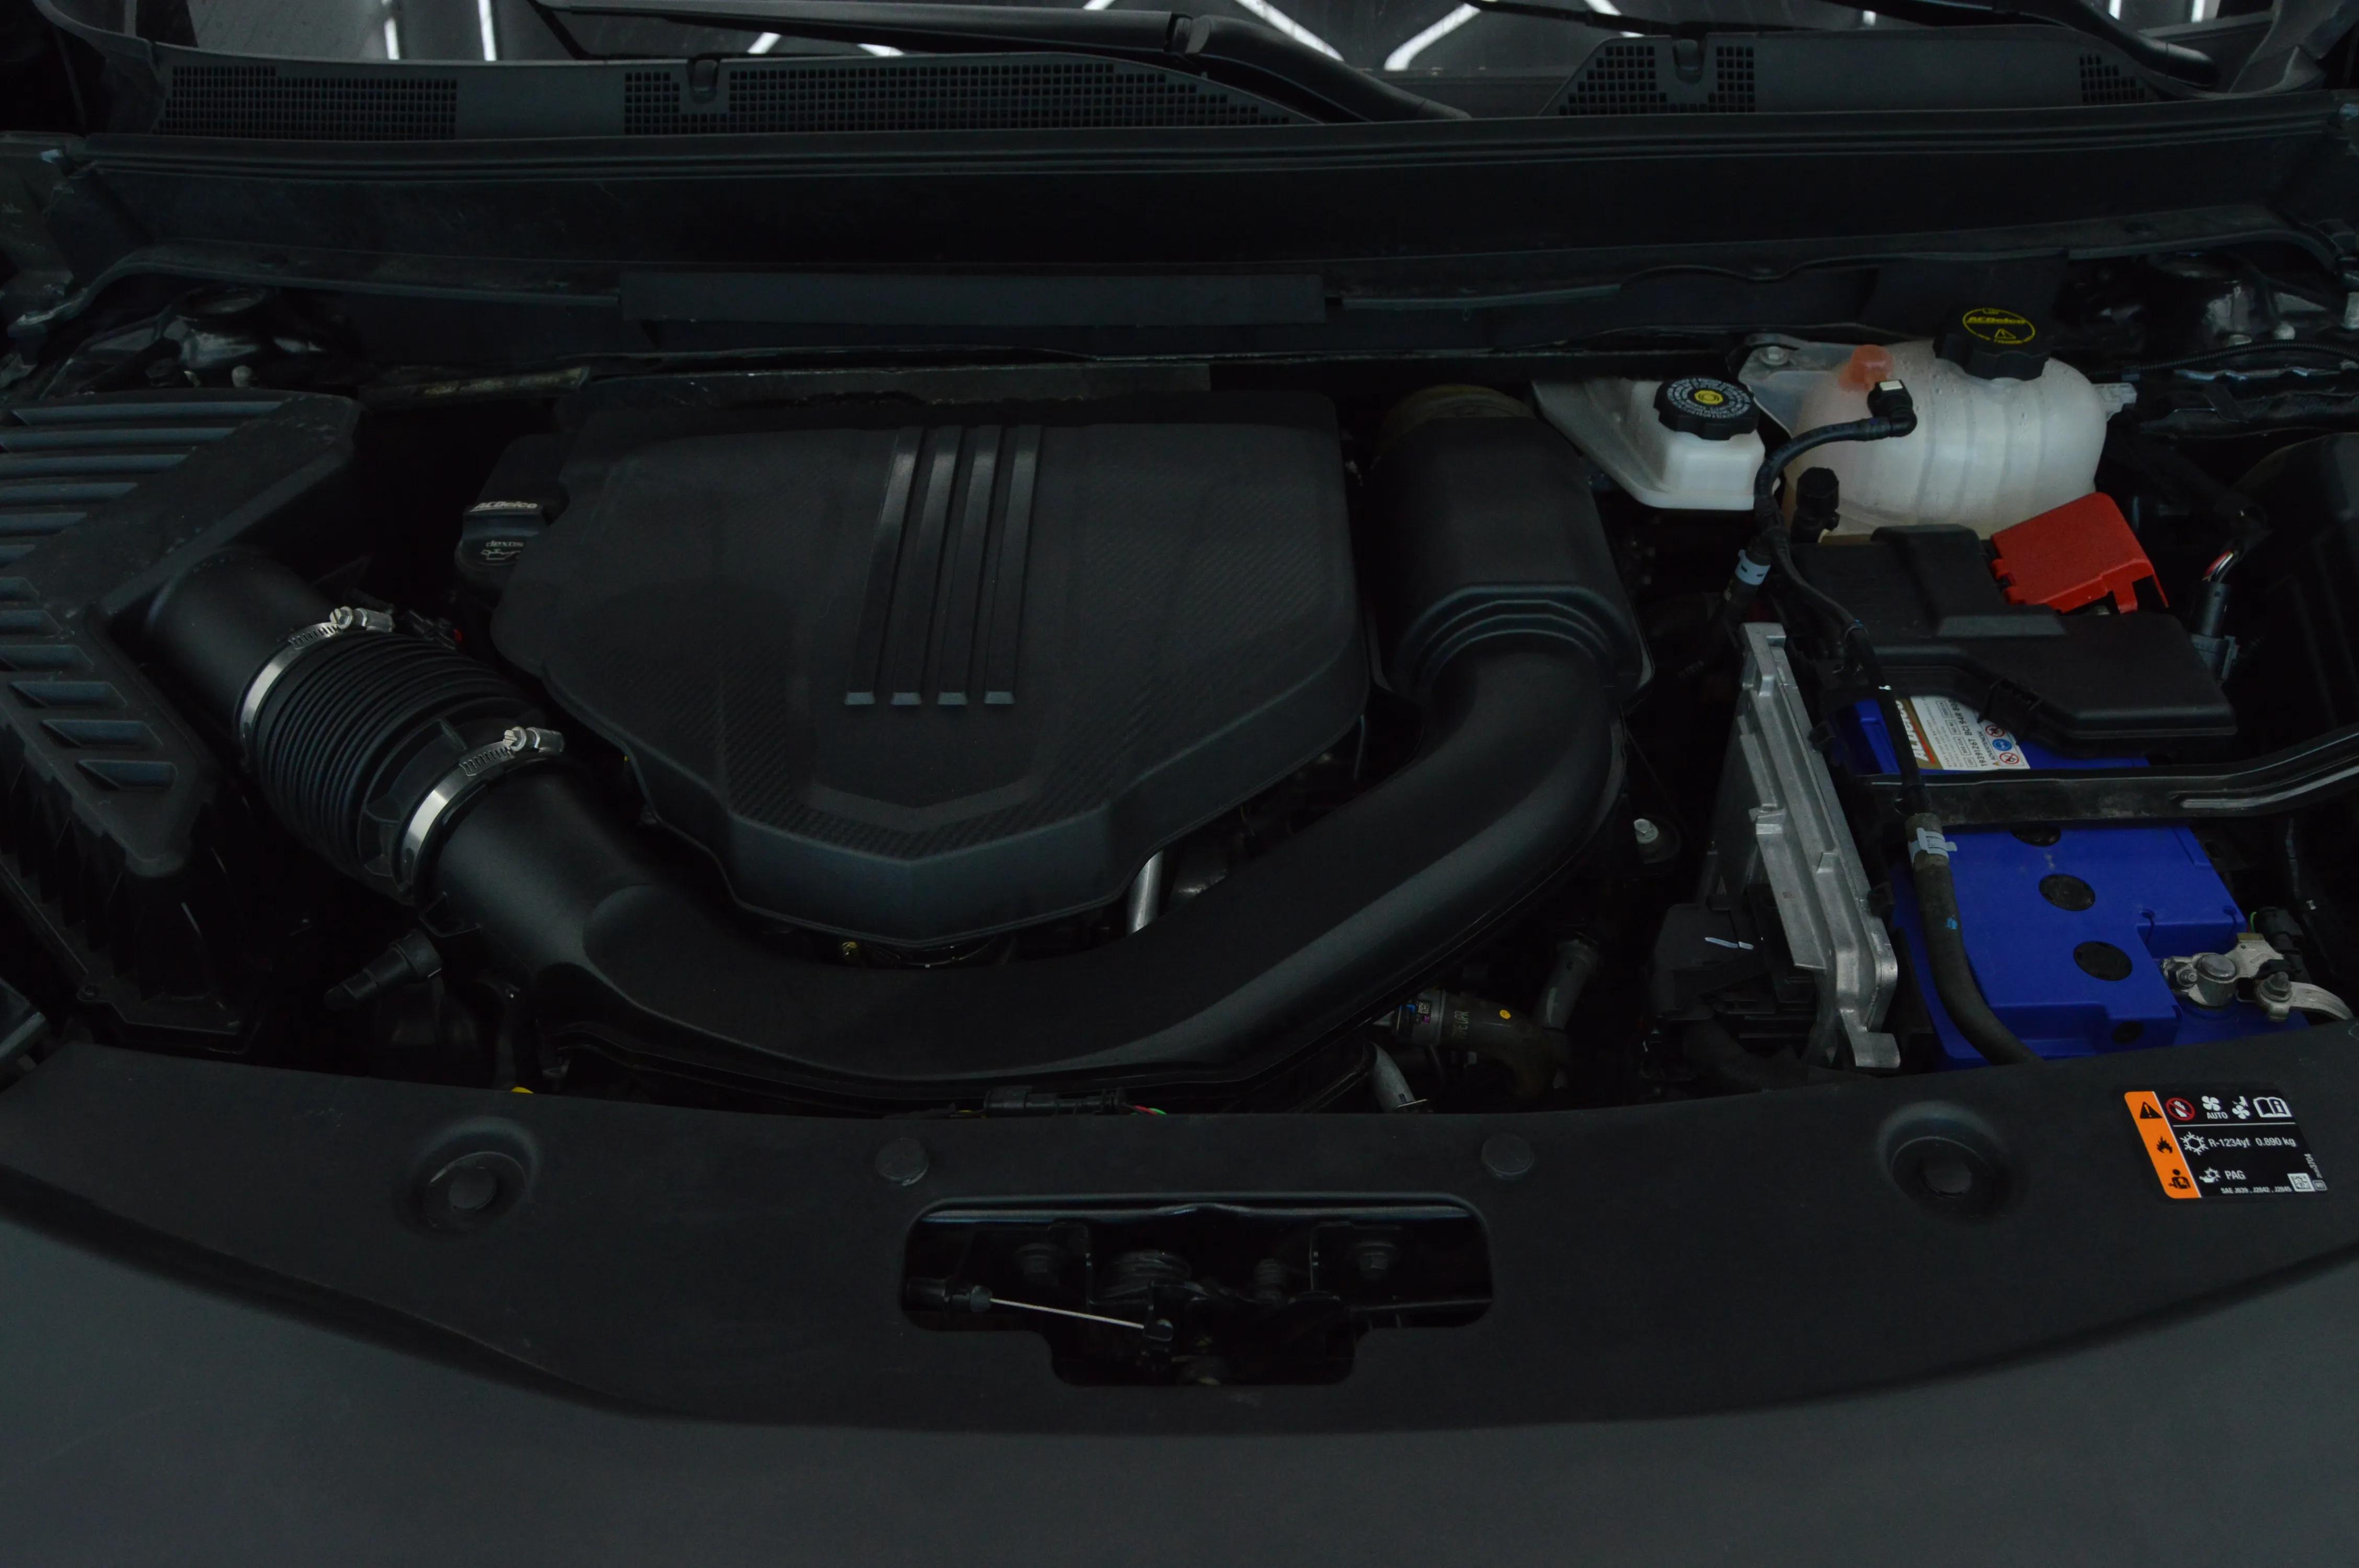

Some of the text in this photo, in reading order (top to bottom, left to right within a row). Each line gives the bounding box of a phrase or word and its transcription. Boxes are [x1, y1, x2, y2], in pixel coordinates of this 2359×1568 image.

[471, 501, 537, 511] ACDelco
[1961, 724, 1972, 735] BCI
[1968, 738, 1987, 766] 19391267
[2207, 1137, 2297, 1148] R-1234yf 0.890 kg
[2224, 1170, 2247, 1180] PAG
